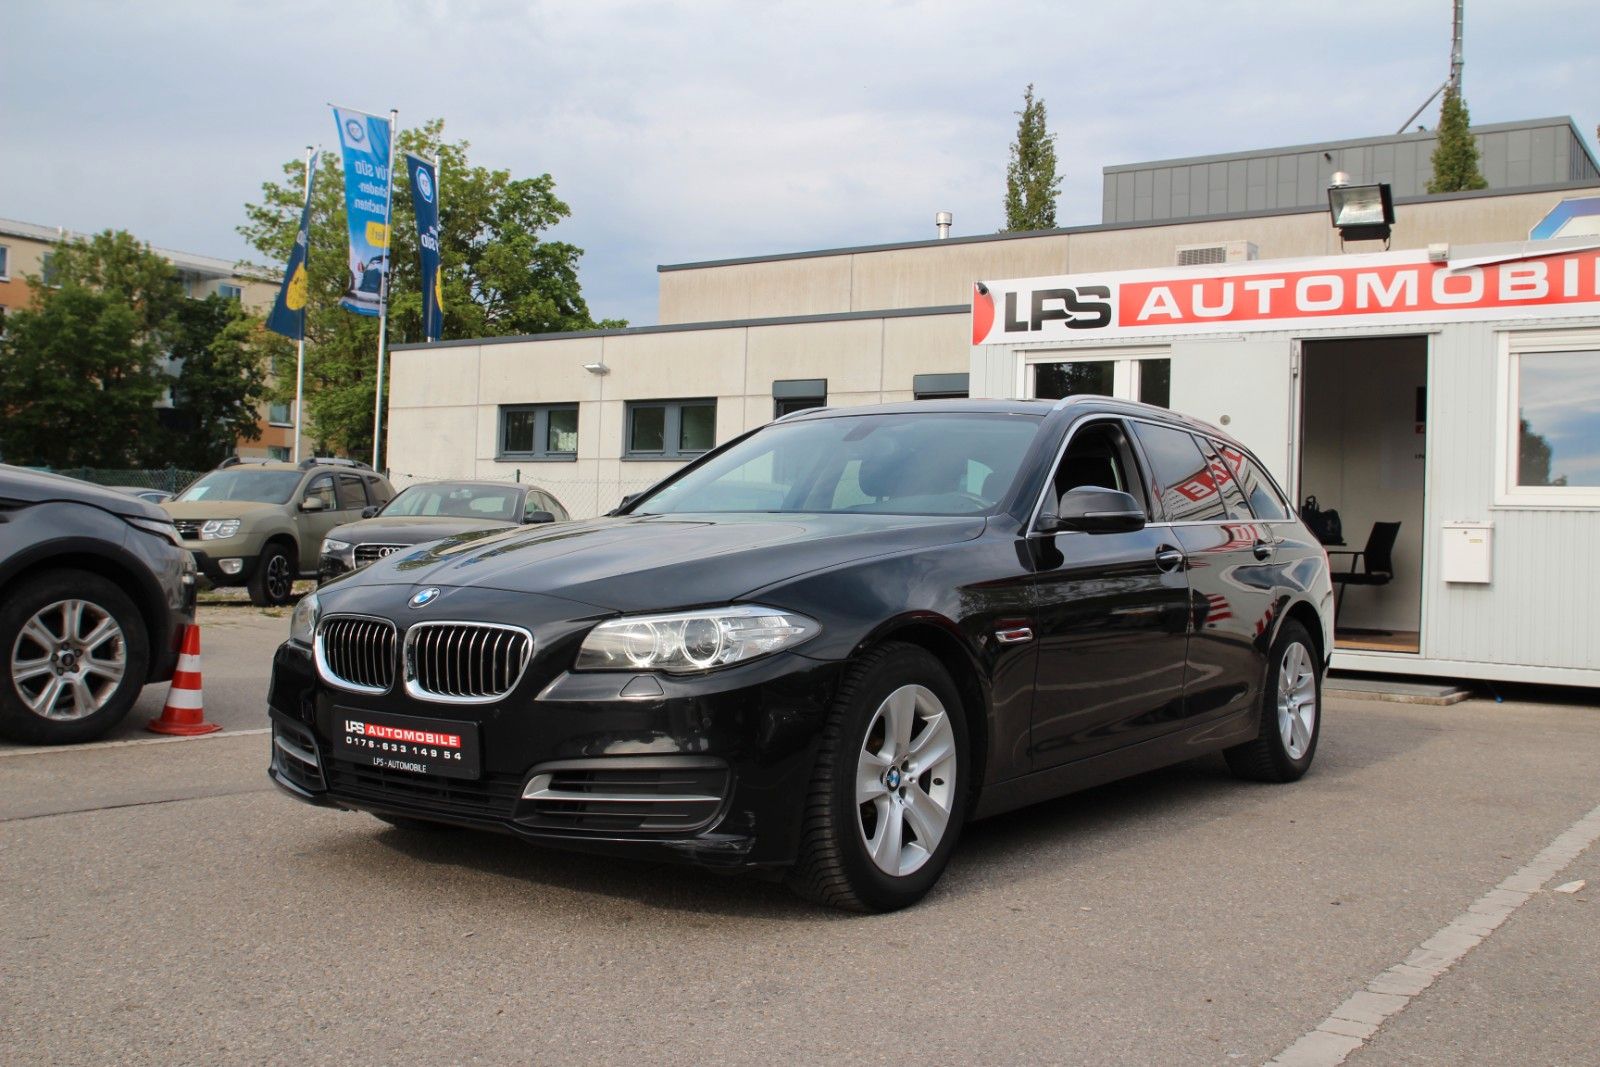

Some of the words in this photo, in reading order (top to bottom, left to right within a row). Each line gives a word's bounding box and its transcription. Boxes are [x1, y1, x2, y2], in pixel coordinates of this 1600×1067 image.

[1005, 286, 1111, 332] LPS
[1137, 257, 1600, 321] AUTOMOBI
[345, 720, 364, 734] LPS
[368, 725, 458, 746] AUTOMOBILE
[373, 756, 384, 766] LPS
[388, 759, 427, 773] AUTOMOBILE
